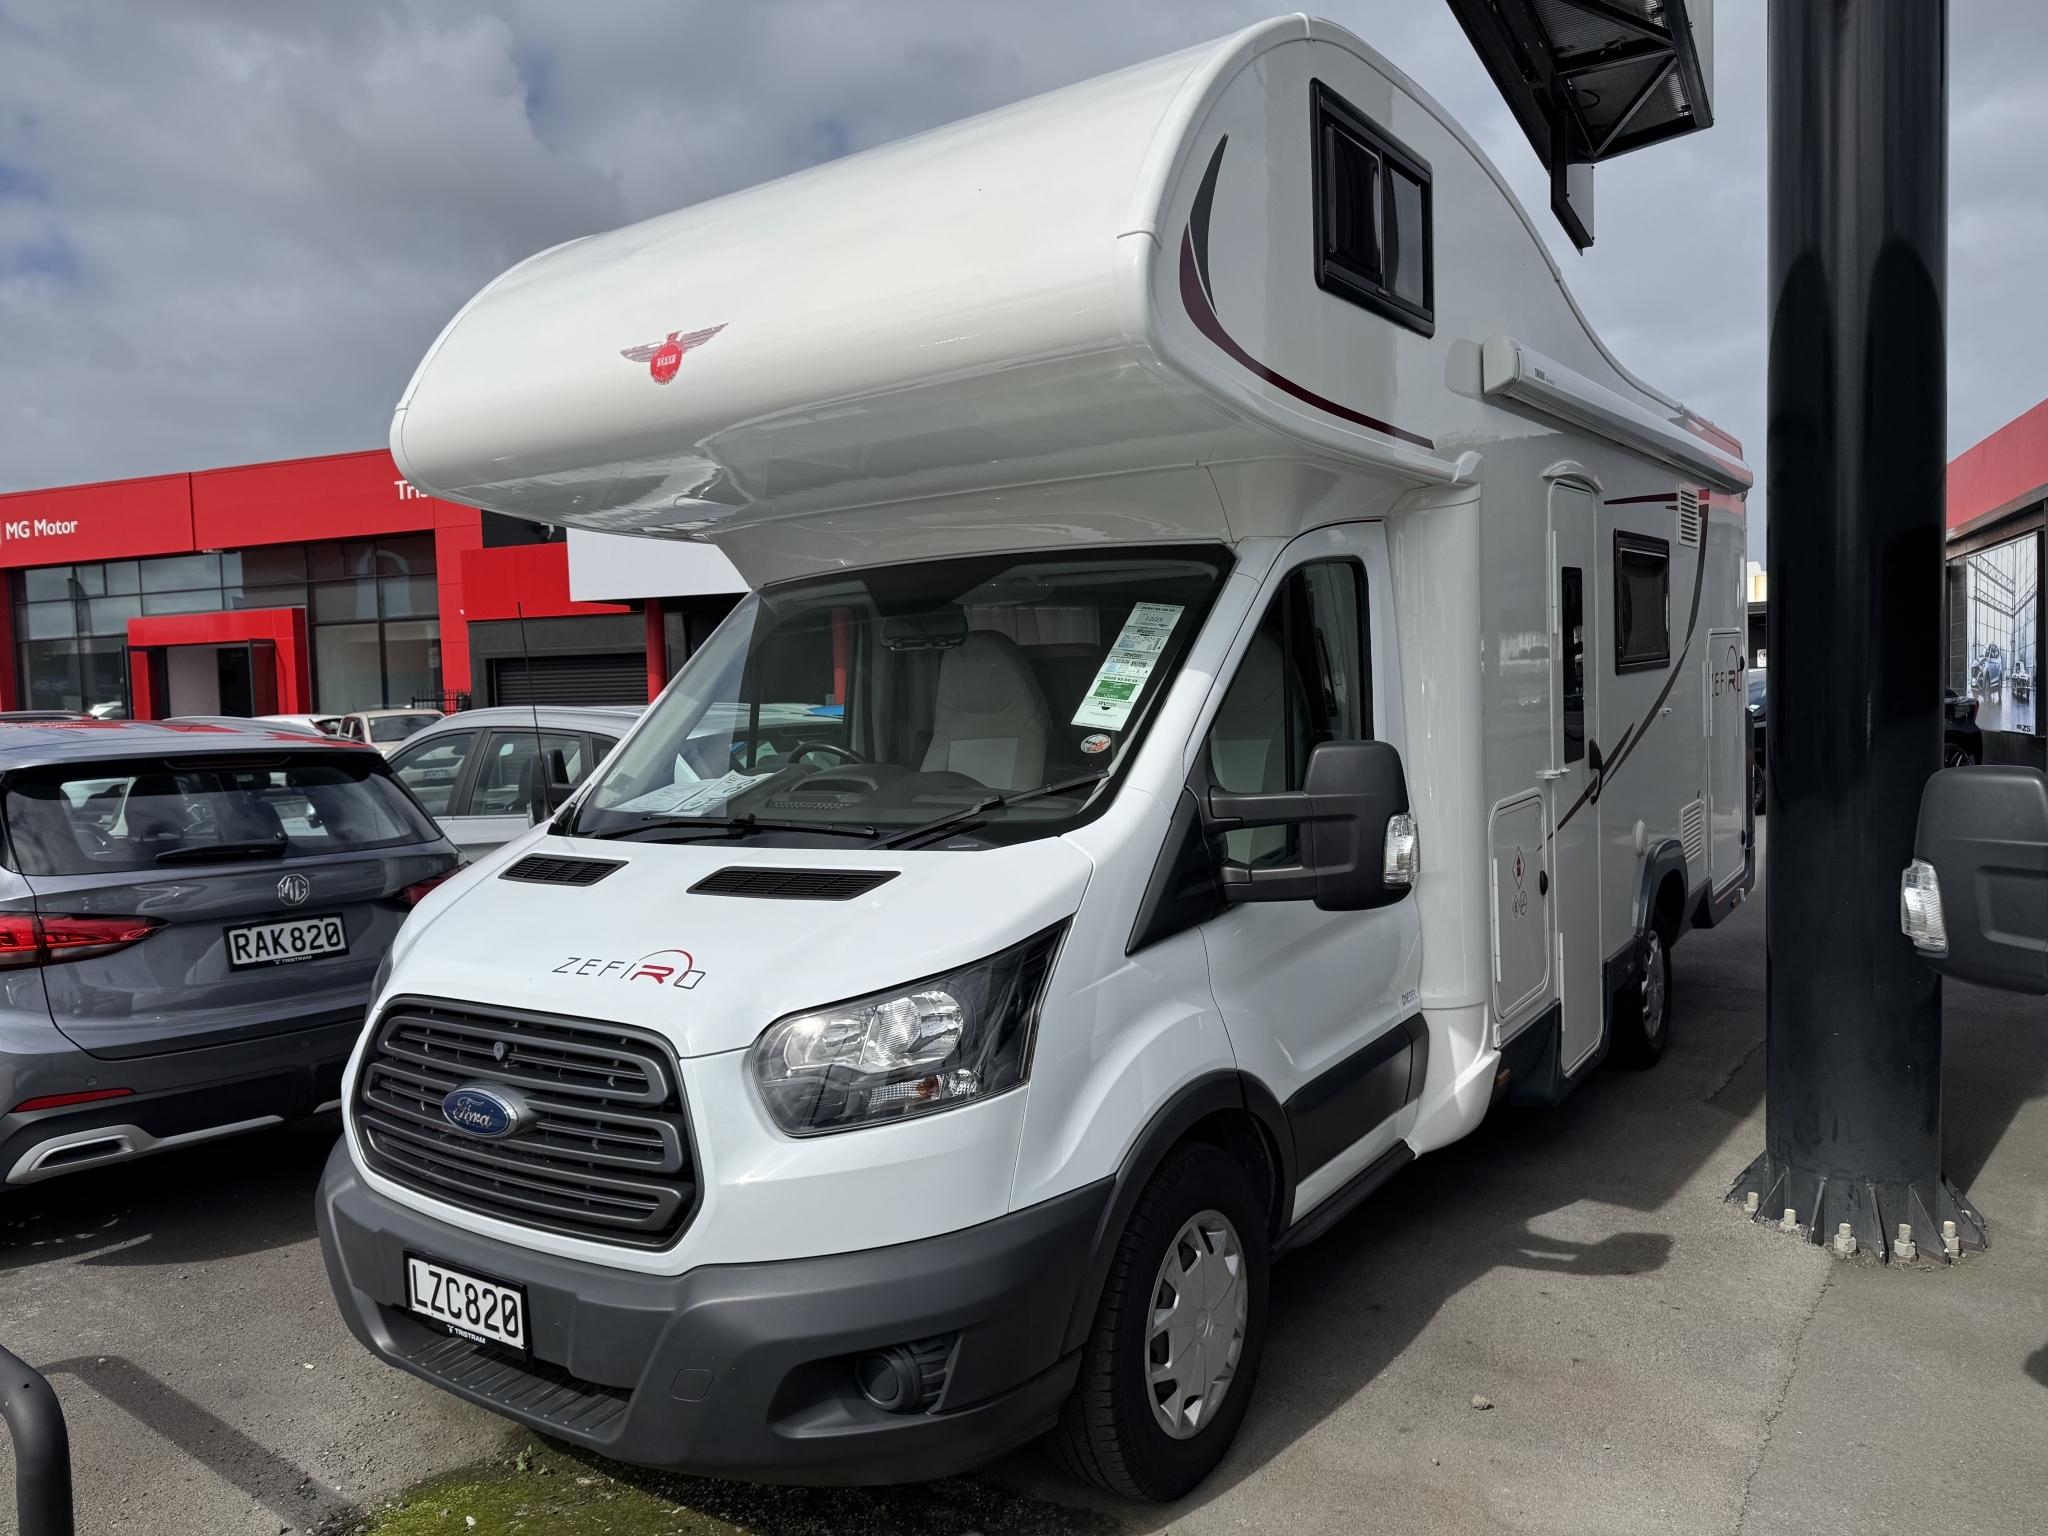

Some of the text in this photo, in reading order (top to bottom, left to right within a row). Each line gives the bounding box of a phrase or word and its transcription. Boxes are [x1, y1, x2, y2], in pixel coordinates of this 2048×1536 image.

[5, 518, 79, 540] MG Motor
[278, 876, 308, 903] MG
[233, 922, 342, 961] RAK820
[281, 955, 313, 964] TRISTRAM
[551, 949, 706, 990] ZEFIRO
[452, 1096, 494, 1129] Ford
[412, 1263, 519, 1339] LZC820
[454, 1327, 486, 1345] TRISTRAM
